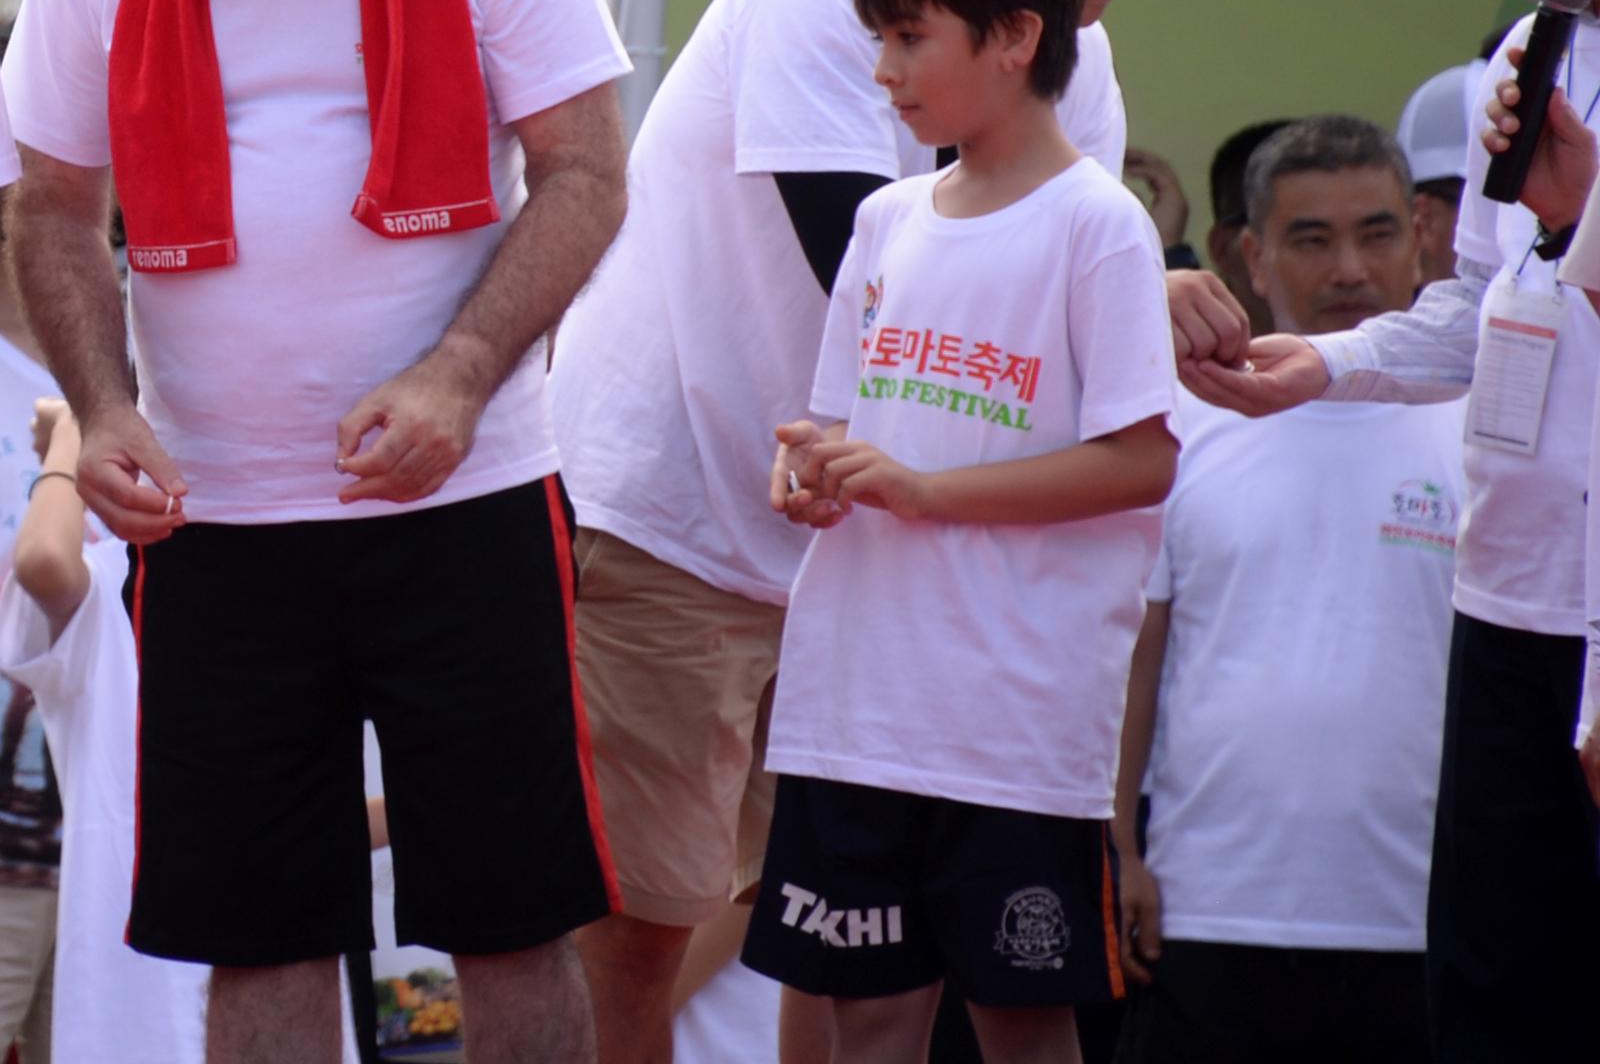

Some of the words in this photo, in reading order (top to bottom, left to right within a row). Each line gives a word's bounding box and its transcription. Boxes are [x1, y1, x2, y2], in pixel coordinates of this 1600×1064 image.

[132, 249, 188, 269] renoma
[861, 326, 1042, 403] 토마토축제
[899, 378, 1033, 432] FESTIVAL
[780, 881, 904, 949] TAKHI
